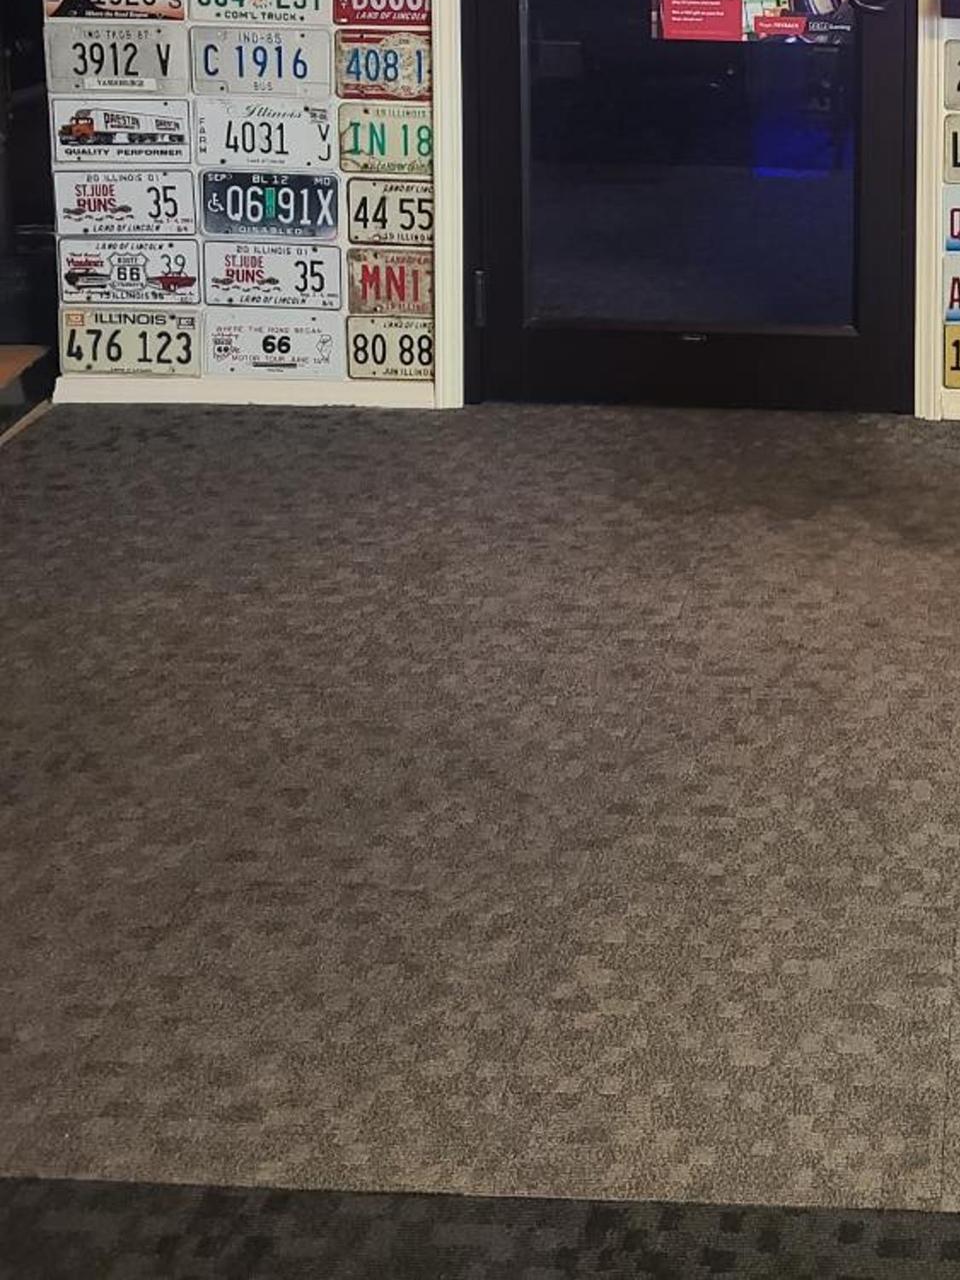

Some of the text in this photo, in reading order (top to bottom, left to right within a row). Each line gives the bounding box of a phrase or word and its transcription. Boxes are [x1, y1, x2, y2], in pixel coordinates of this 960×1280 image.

[64, 147, 182, 157] QUALITY PERFORMER
[225, 122, 289, 155] 4031
[148, 187, 178, 218] 35
[354, 197, 387, 229] 44
[66, 331, 191, 364] 476 123
[262, 336, 290, 353] 66
